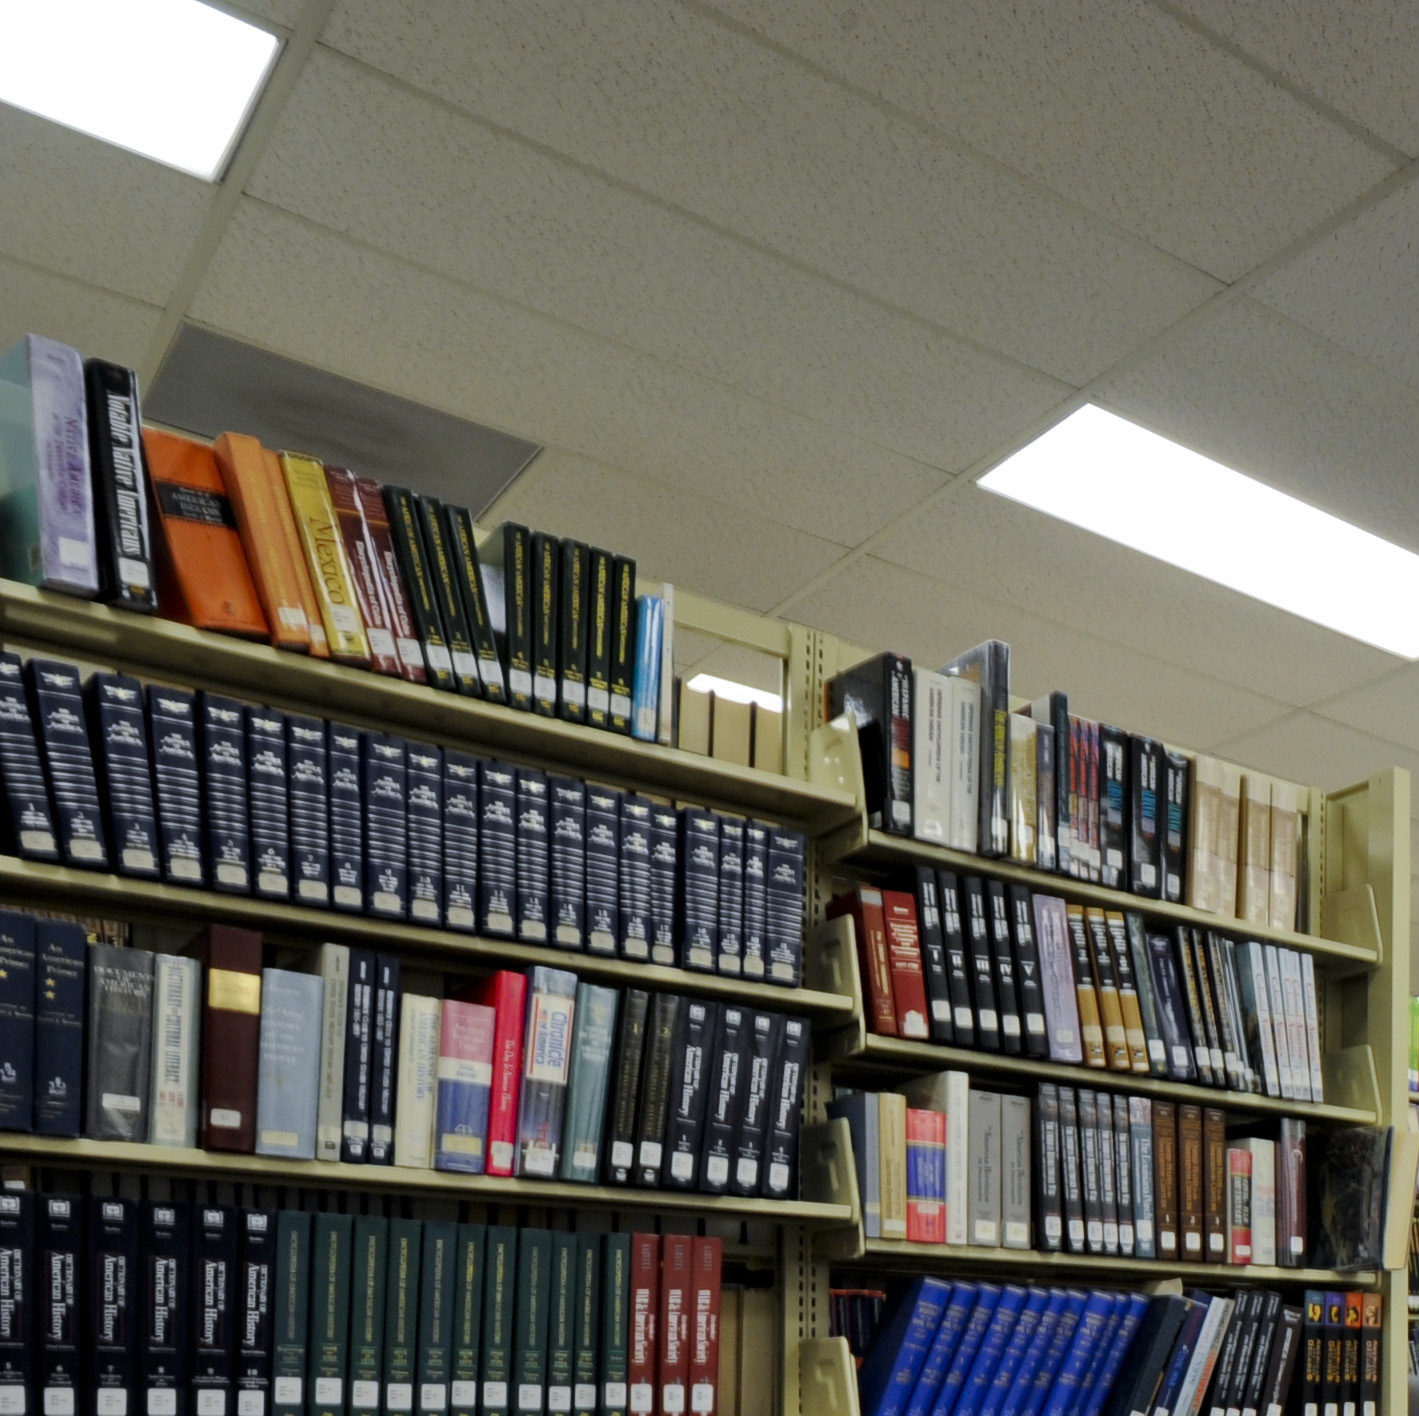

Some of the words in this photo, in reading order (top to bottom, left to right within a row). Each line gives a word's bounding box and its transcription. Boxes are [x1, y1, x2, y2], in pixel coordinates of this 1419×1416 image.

[107, 391, 131, 446] Notable
[112, 446, 137, 492] Native
[117, 490, 142, 555] Americans
[310, 516, 346, 605] Mexico
[551, 1011, 568, 1068] Chronicle
[52, 1252, 65, 1300] American
[103, 1253, 117, 1301] American
[155, 1257, 169, 1304] American
[204, 1260, 218, 1306] American
[247, 1263, 261, 1308] American
[0, 1299, 15, 1338] History
[48, 1302, 66, 1341] History
[100, 1304, 117, 1342] History
[151, 1306, 168, 1343] History
[201, 1308, 218, 1345] History
[243, 1310, 260, 1346] History
